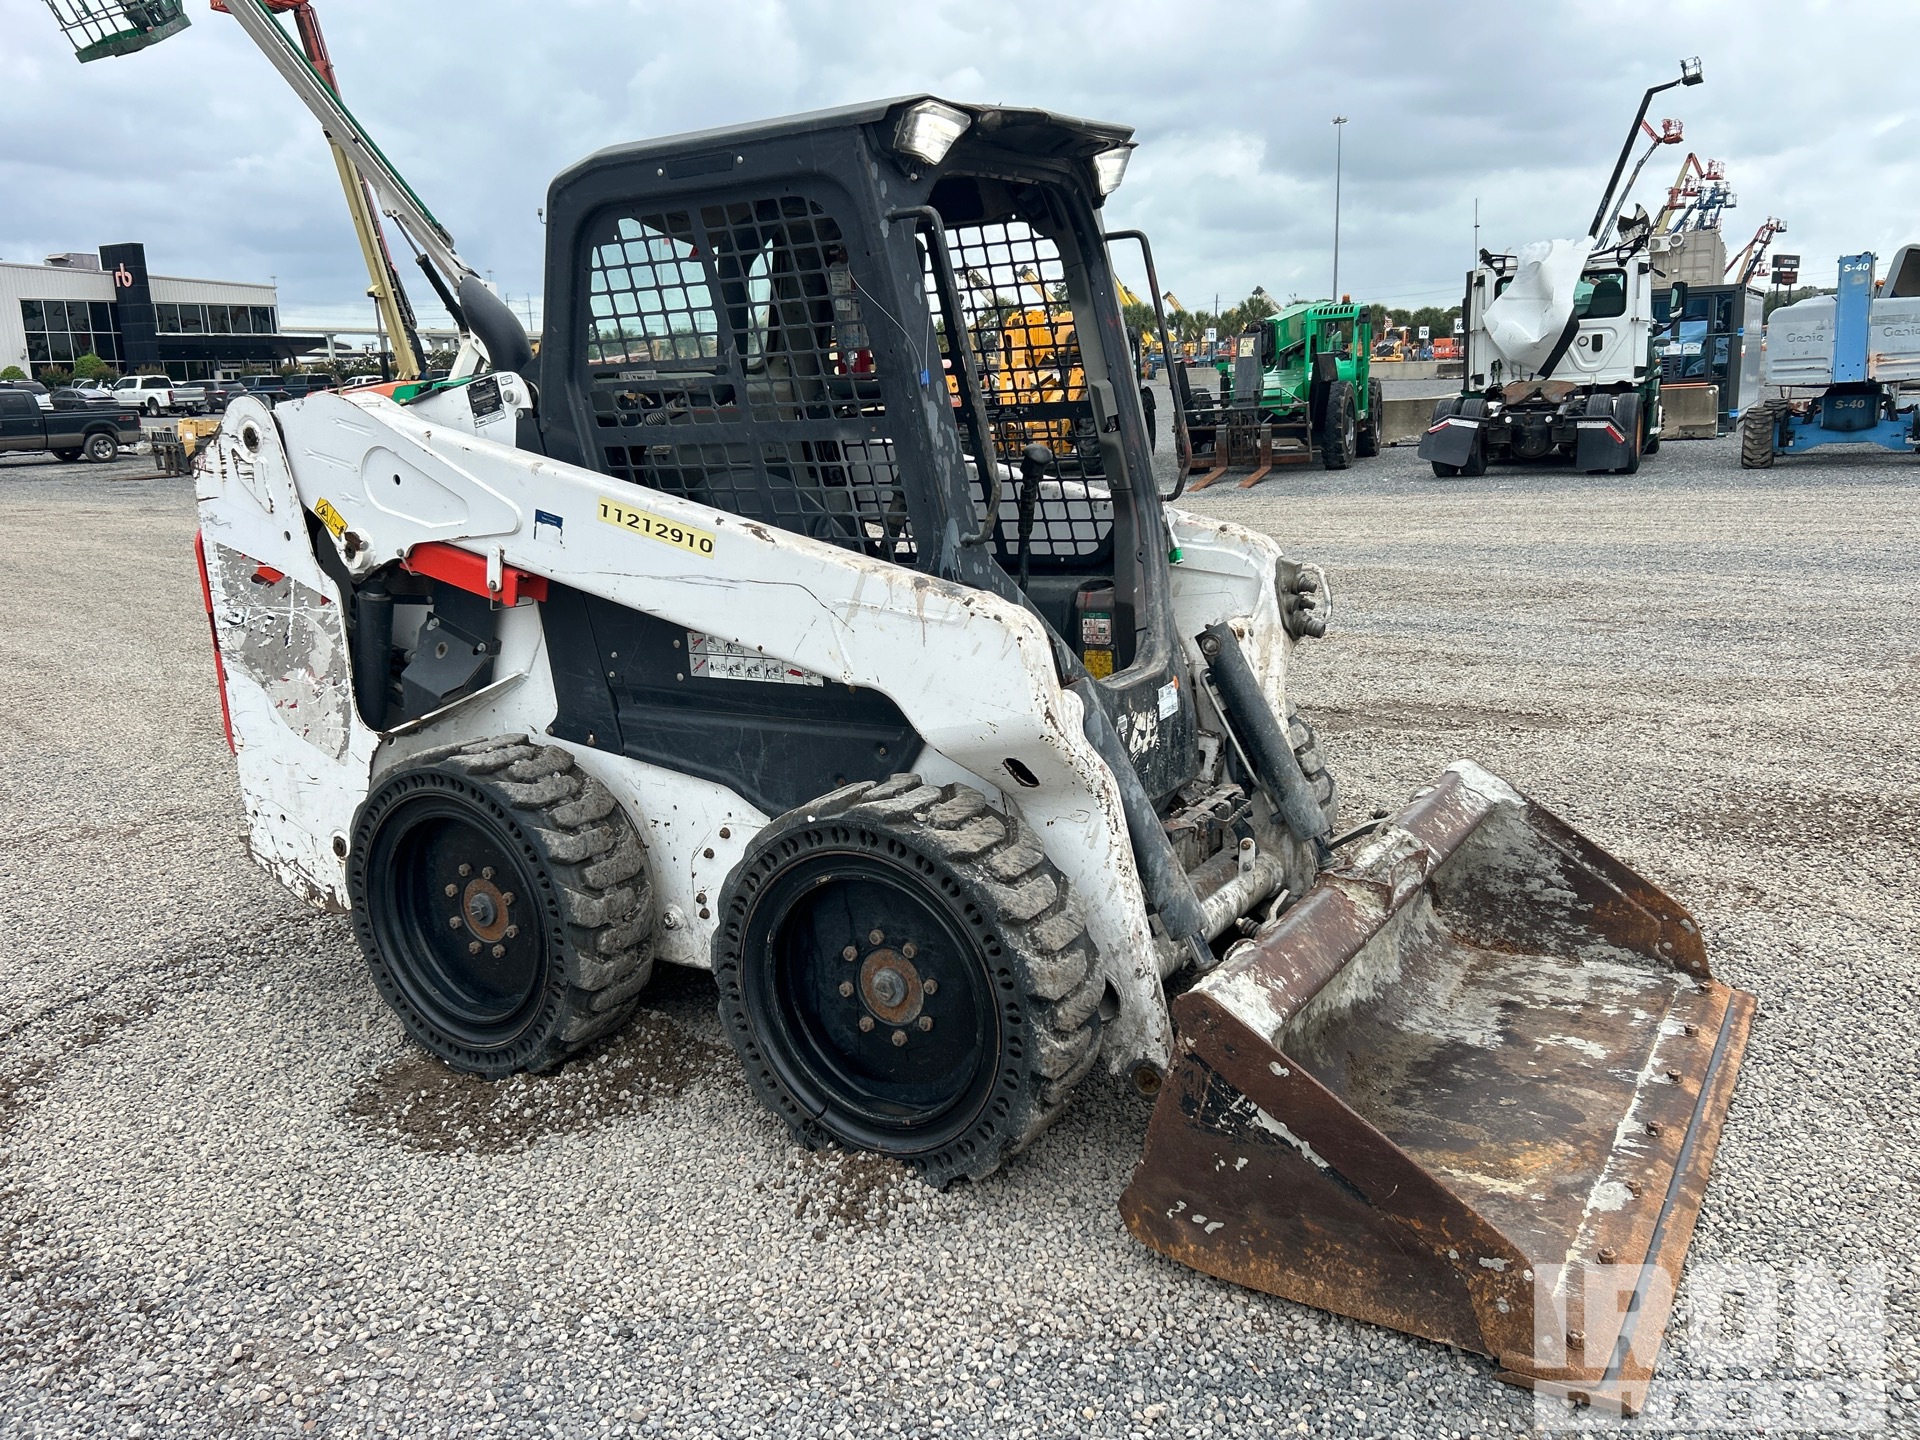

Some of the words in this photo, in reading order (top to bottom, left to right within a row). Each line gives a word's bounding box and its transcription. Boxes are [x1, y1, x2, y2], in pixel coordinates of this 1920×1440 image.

[1843, 262, 1870, 272] S-40
[115, 262, 133, 288] rb
[1786, 332, 1824, 343] Genie
[1834, 399, 1865, 409] S-40
[600, 503, 714, 553] 11212910
